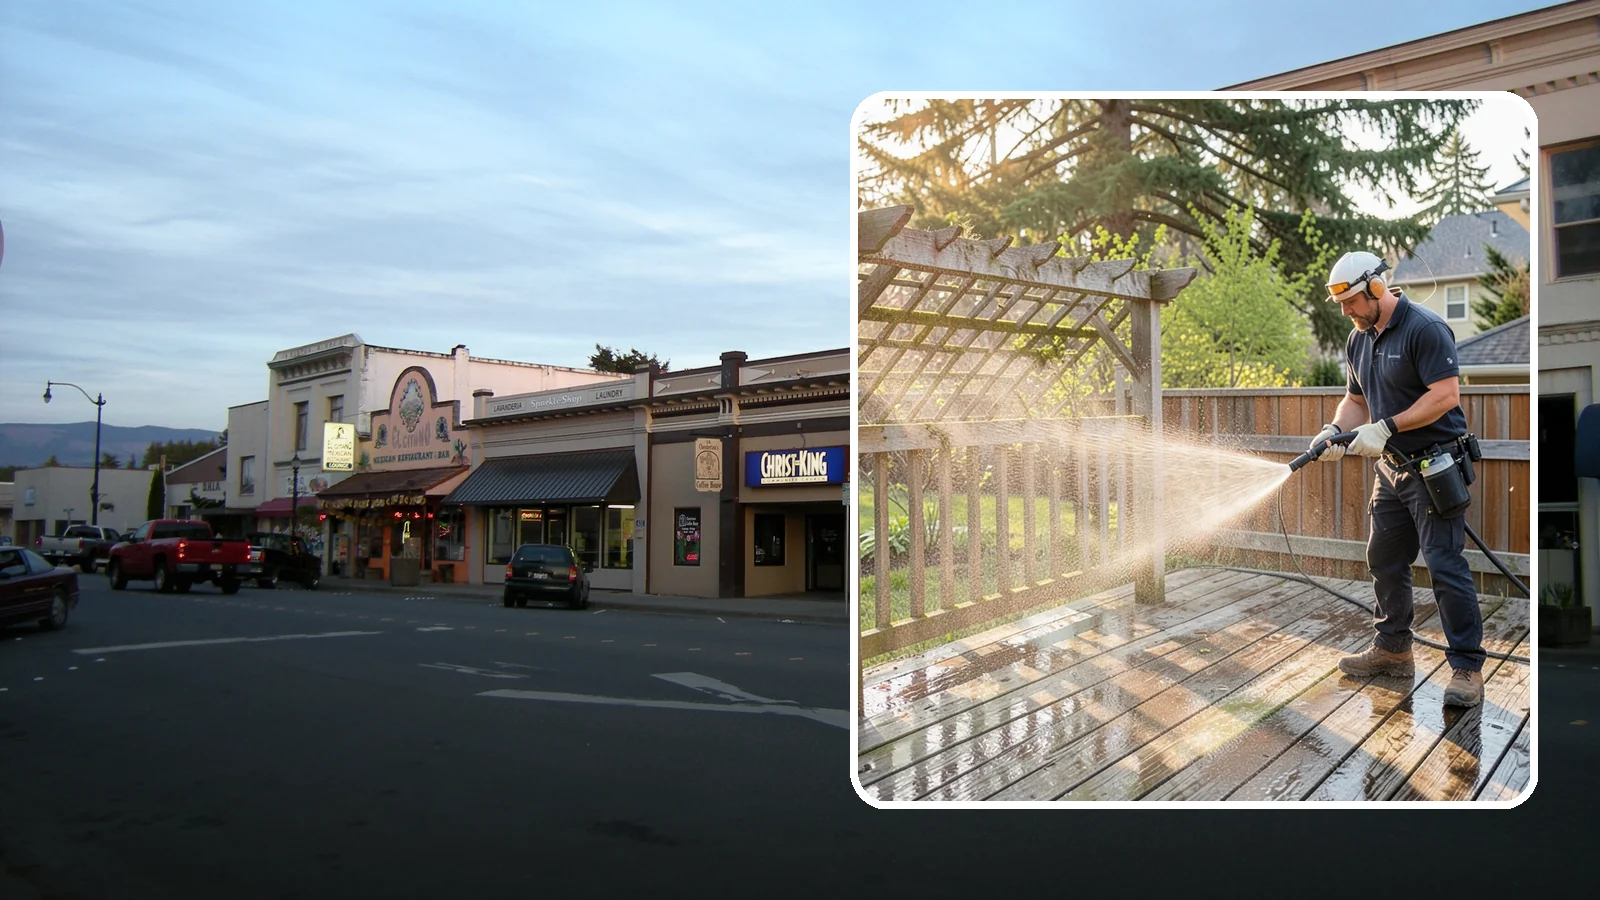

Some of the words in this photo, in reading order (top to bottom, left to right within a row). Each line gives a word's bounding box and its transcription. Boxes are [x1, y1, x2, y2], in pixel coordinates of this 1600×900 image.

[595, 389, 624, 400] LAUNDRY
[493, 402, 523, 412] LAVANDERIA
[530, 397, 561, 409] Sparkle
[561, 394, 582, 405] Shop
[374, 454, 396, 464] MEXICAN
[397, 451, 433, 462] RESTAURANT
[437, 450, 450, 458] BAR
[760, 452, 797, 478] CHRIST
[799, 450, 827, 476] KING
[709, 481, 721, 489] House
